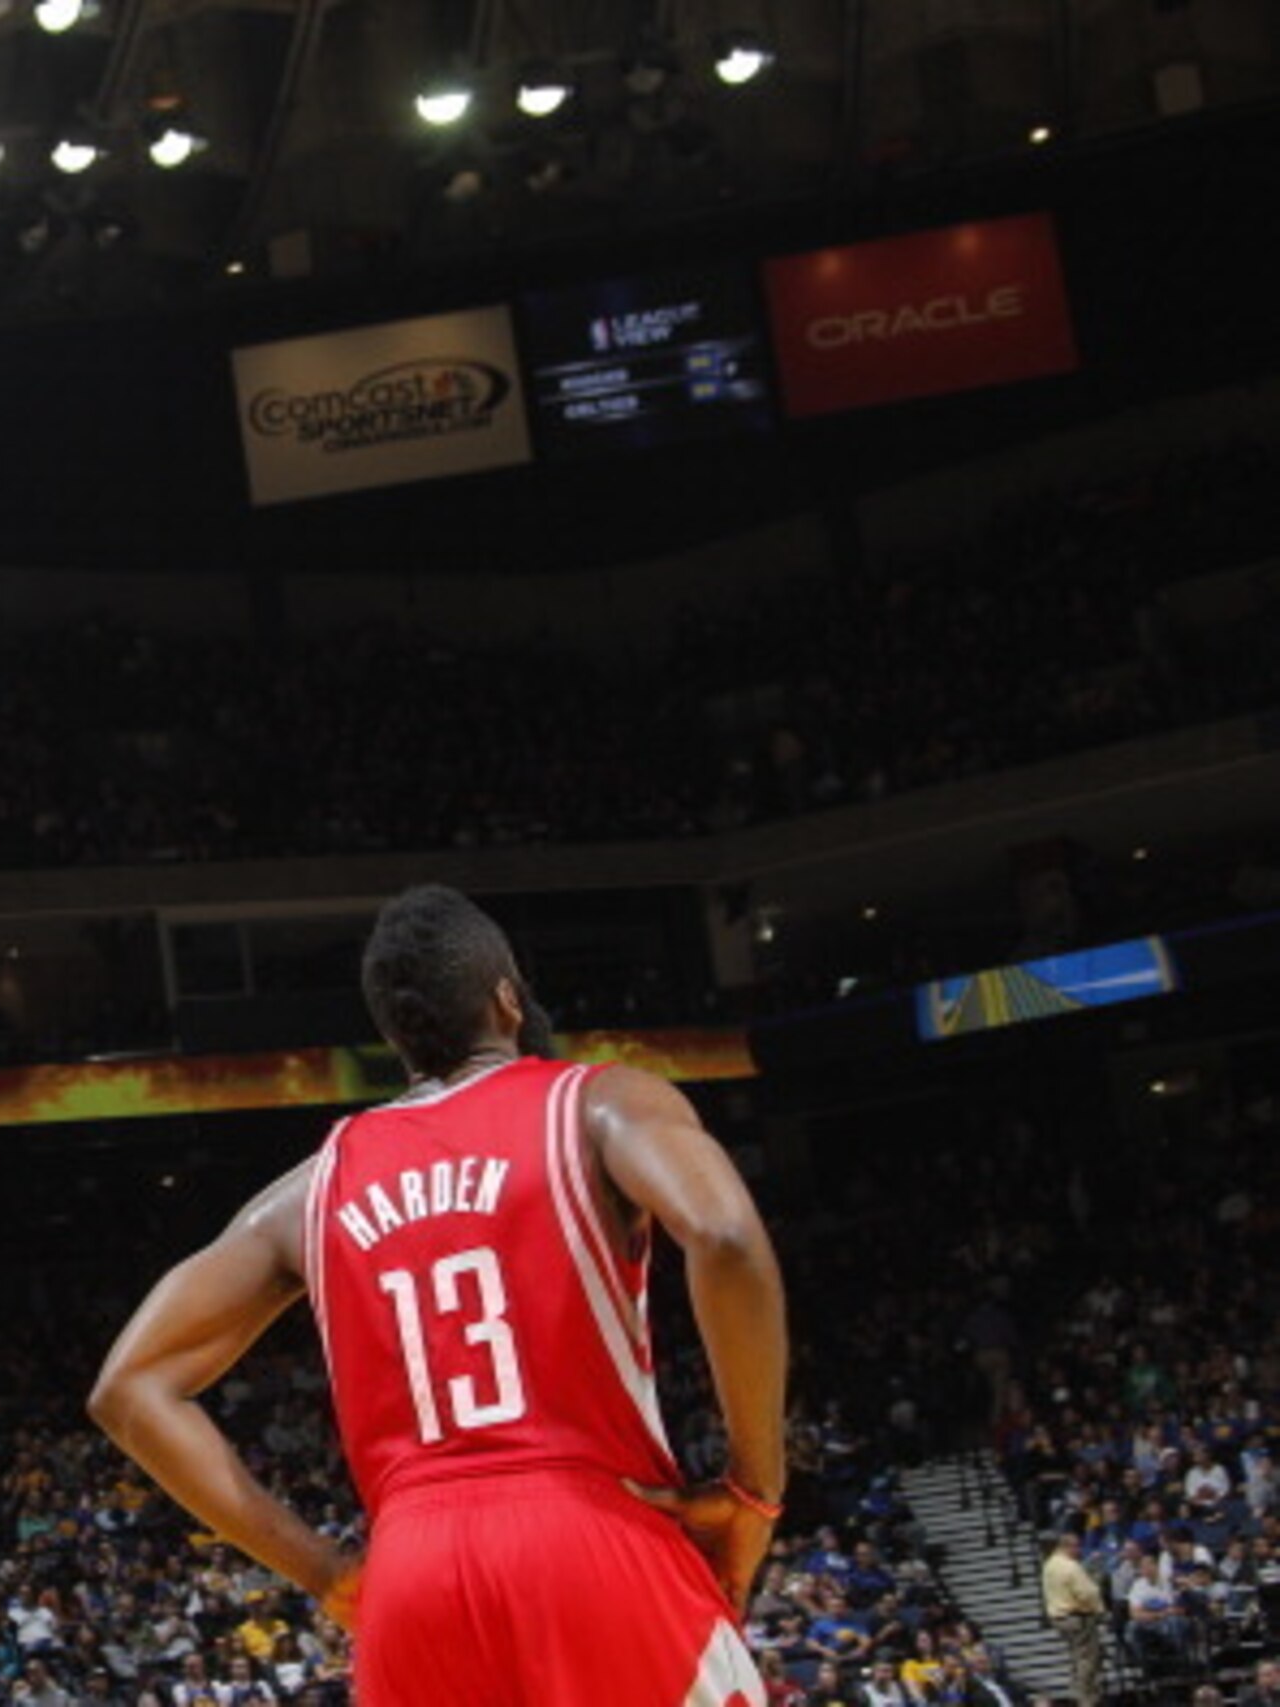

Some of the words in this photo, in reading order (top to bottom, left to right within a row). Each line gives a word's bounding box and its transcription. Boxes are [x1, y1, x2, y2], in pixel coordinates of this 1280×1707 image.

[807, 286, 1024, 349] ORACLE
[338, 1157, 510, 1251] HARDEN
[378, 1246, 526, 1444] 13
